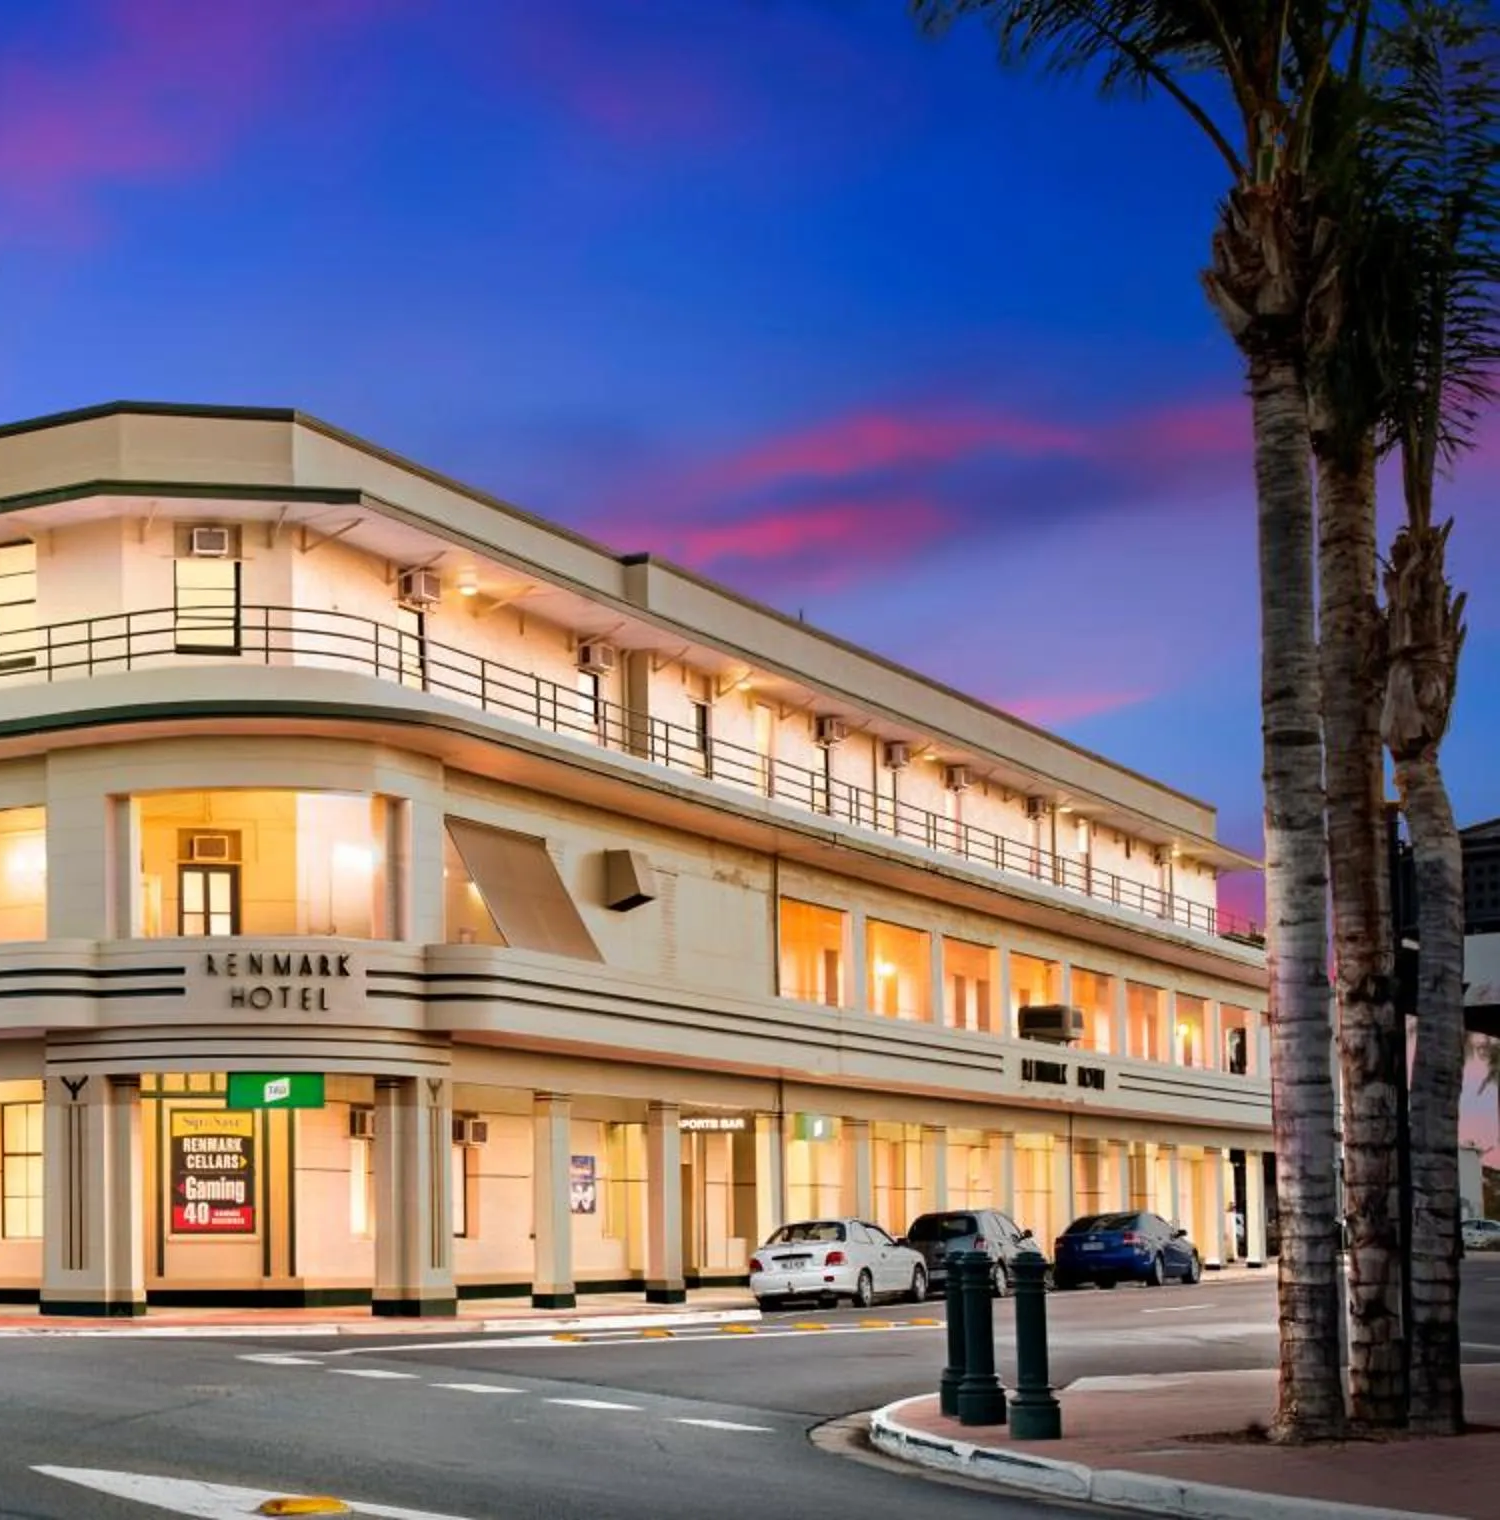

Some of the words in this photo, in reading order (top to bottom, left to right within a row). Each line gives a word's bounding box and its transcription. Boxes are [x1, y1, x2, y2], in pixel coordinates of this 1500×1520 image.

[206, 953, 350, 977] RENMARK
[230, 986, 330, 1011] HOTEL
[720, 1119, 745, 1129] BAR
[183, 1137, 243, 1153] RENMARK
[186, 1154, 239, 1169] CELLARS
[185, 1176, 245, 1204] Gaming
[183, 1202, 209, 1225] 40
